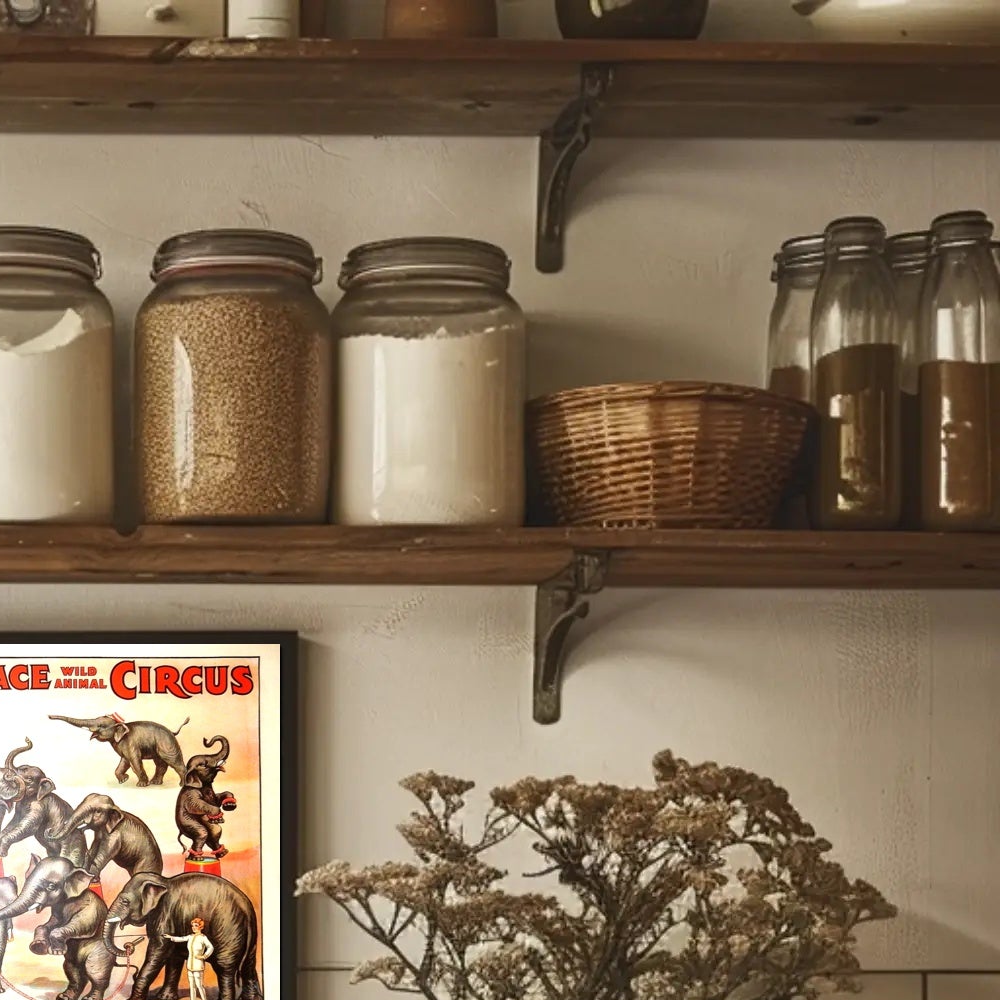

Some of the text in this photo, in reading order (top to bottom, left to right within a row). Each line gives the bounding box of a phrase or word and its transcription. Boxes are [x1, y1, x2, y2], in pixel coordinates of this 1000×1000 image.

[60, 666, 98, 677] WILD
[54, 678, 107, 689] ANIMAL
[110, 660, 254, 700] CIRCUS
